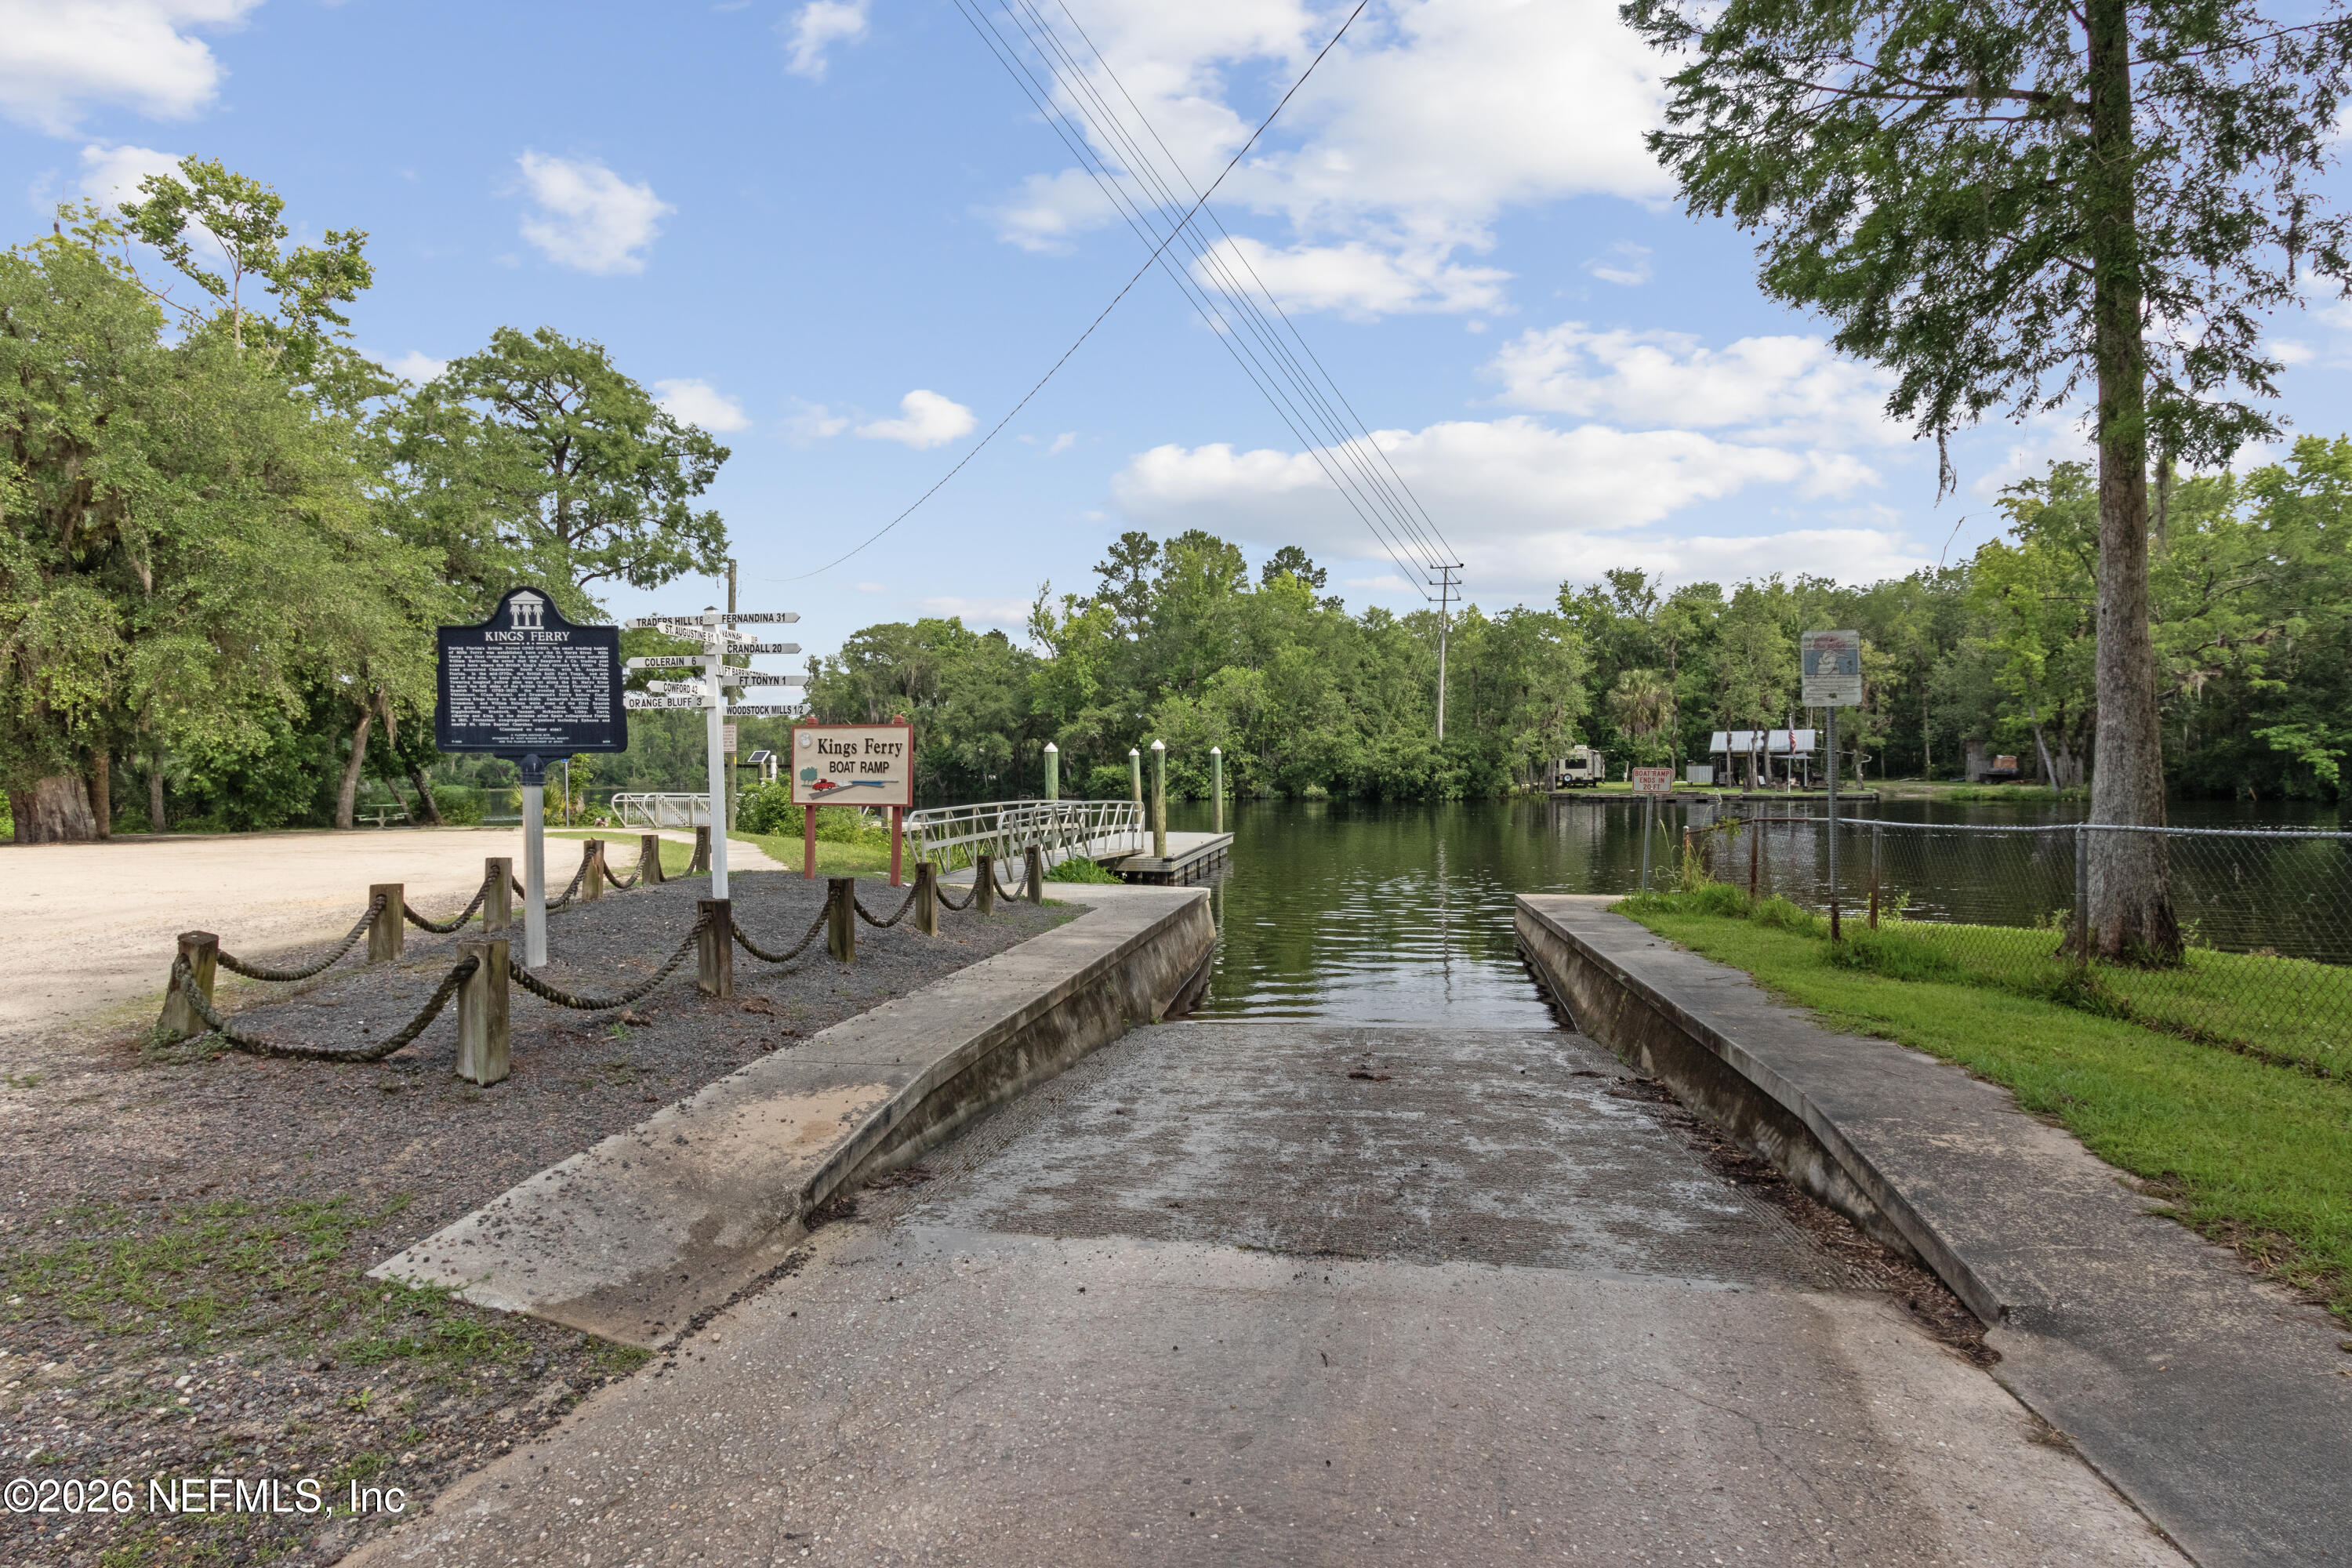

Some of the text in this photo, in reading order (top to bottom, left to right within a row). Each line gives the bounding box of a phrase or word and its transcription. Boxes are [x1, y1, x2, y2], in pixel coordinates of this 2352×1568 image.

[675, 616, 692, 626] HILL
[695, 616, 703, 625] 18
[722, 613, 786, 622] FERNANDINA 31
[485, 631, 570, 641] KINGS FERRY
[665, 624, 713, 641] ST. AUGUSTINE 81
[728, 644, 782, 653] CRANDALL 20
[645, 657, 684, 666] COLERAIN
[725, 667, 730, 676] FT
[664, 683, 698, 694] COWFORD 42
[630, 699, 662, 707] ORANGE
[668, 698, 692, 706] BLUFF
[727, 706, 769, 714] WOODSTOCK
[771, 706, 791, 714] MILLS
[818, 739, 903, 757] Kings Ferry
[829, 761, 889, 773] BOAT RAMP
